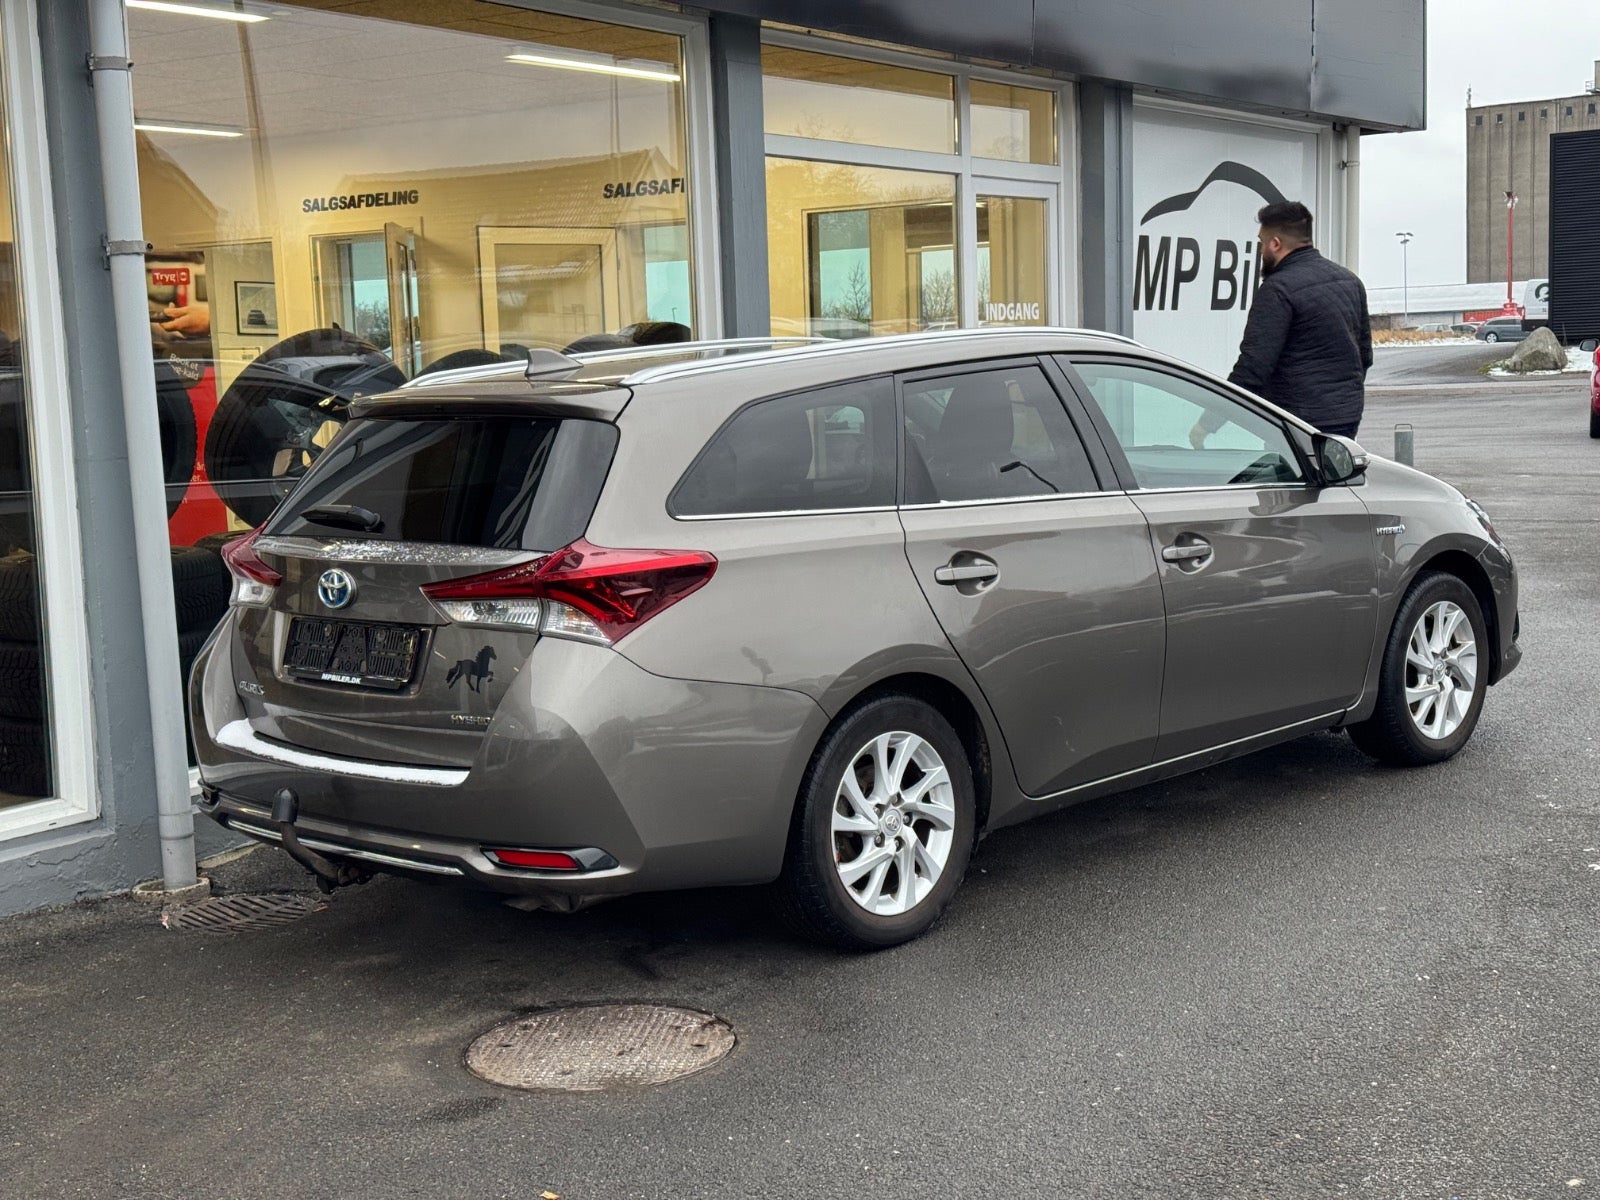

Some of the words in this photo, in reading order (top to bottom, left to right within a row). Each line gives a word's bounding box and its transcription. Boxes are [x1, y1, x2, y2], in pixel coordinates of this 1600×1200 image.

[603, 178, 685, 199] SALGSAF
[302, 190, 419, 213] SALGSAFDELING
[154, 272, 176, 282] Tryg
[1133, 235, 1201, 311] MP
[985, 302, 1040, 320] INDGANG
[321, 673, 362, 685] MPBILER.DK
